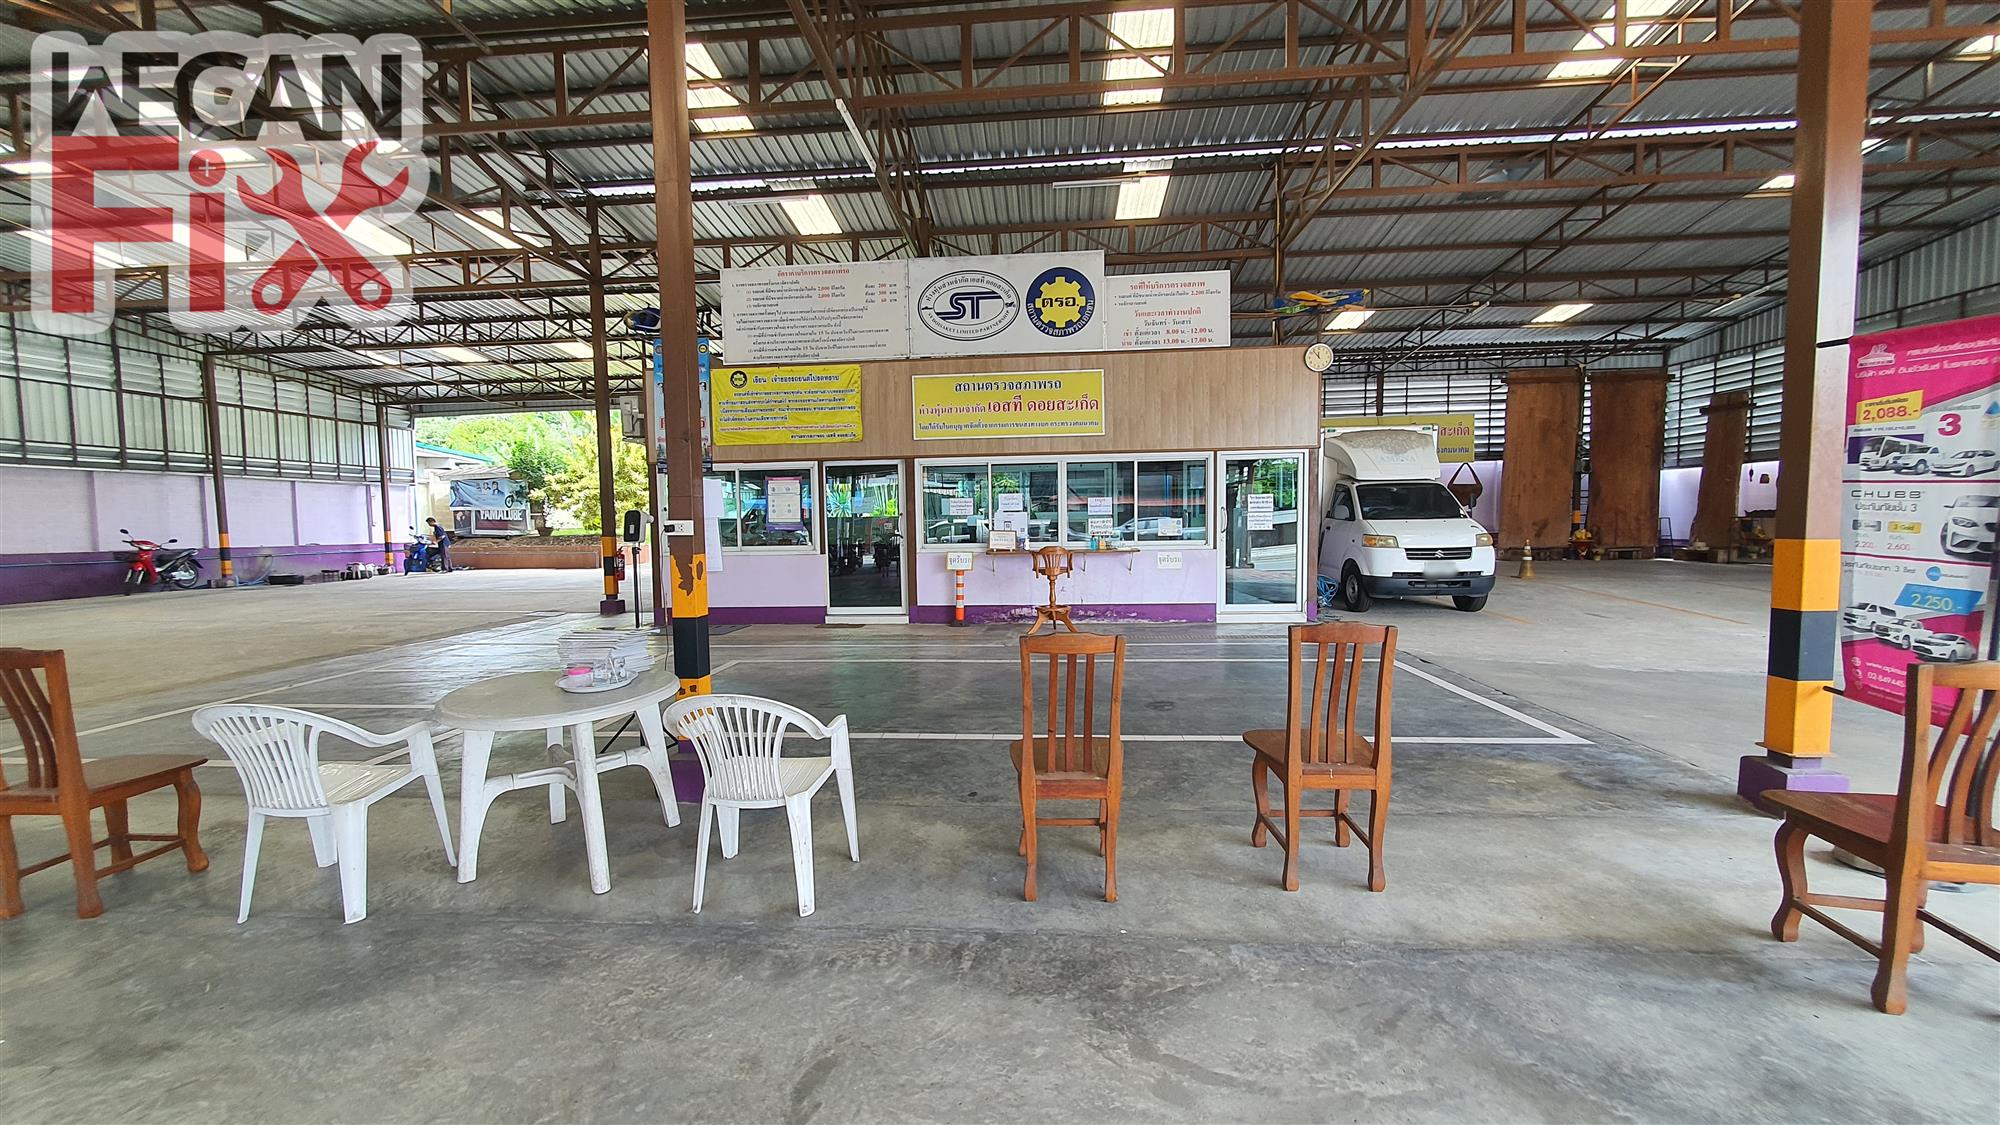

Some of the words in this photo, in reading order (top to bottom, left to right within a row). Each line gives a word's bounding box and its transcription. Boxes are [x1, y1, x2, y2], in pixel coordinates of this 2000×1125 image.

[935, 290, 1003, 320] ST
[1042, 296, 1080, 308] ตรอ.
[954, 379, 1062, 392] สถานตรวจสภาพรถ
[919, 401, 986, 417] ห้างหุ้นส่วนจำกัด
[988, 395, 1022, 412] เอสที
[1027, 393, 1099, 411] ดอยสะเก็ด
[1862, 405, 1919, 422] 2,088.-
[1937, 413, 1962, 436] 3
[1851, 490, 1921, 499] CHUBB
[1910, 503, 1918, 512] 3
[481, 510, 523, 520] YAMALUBE
